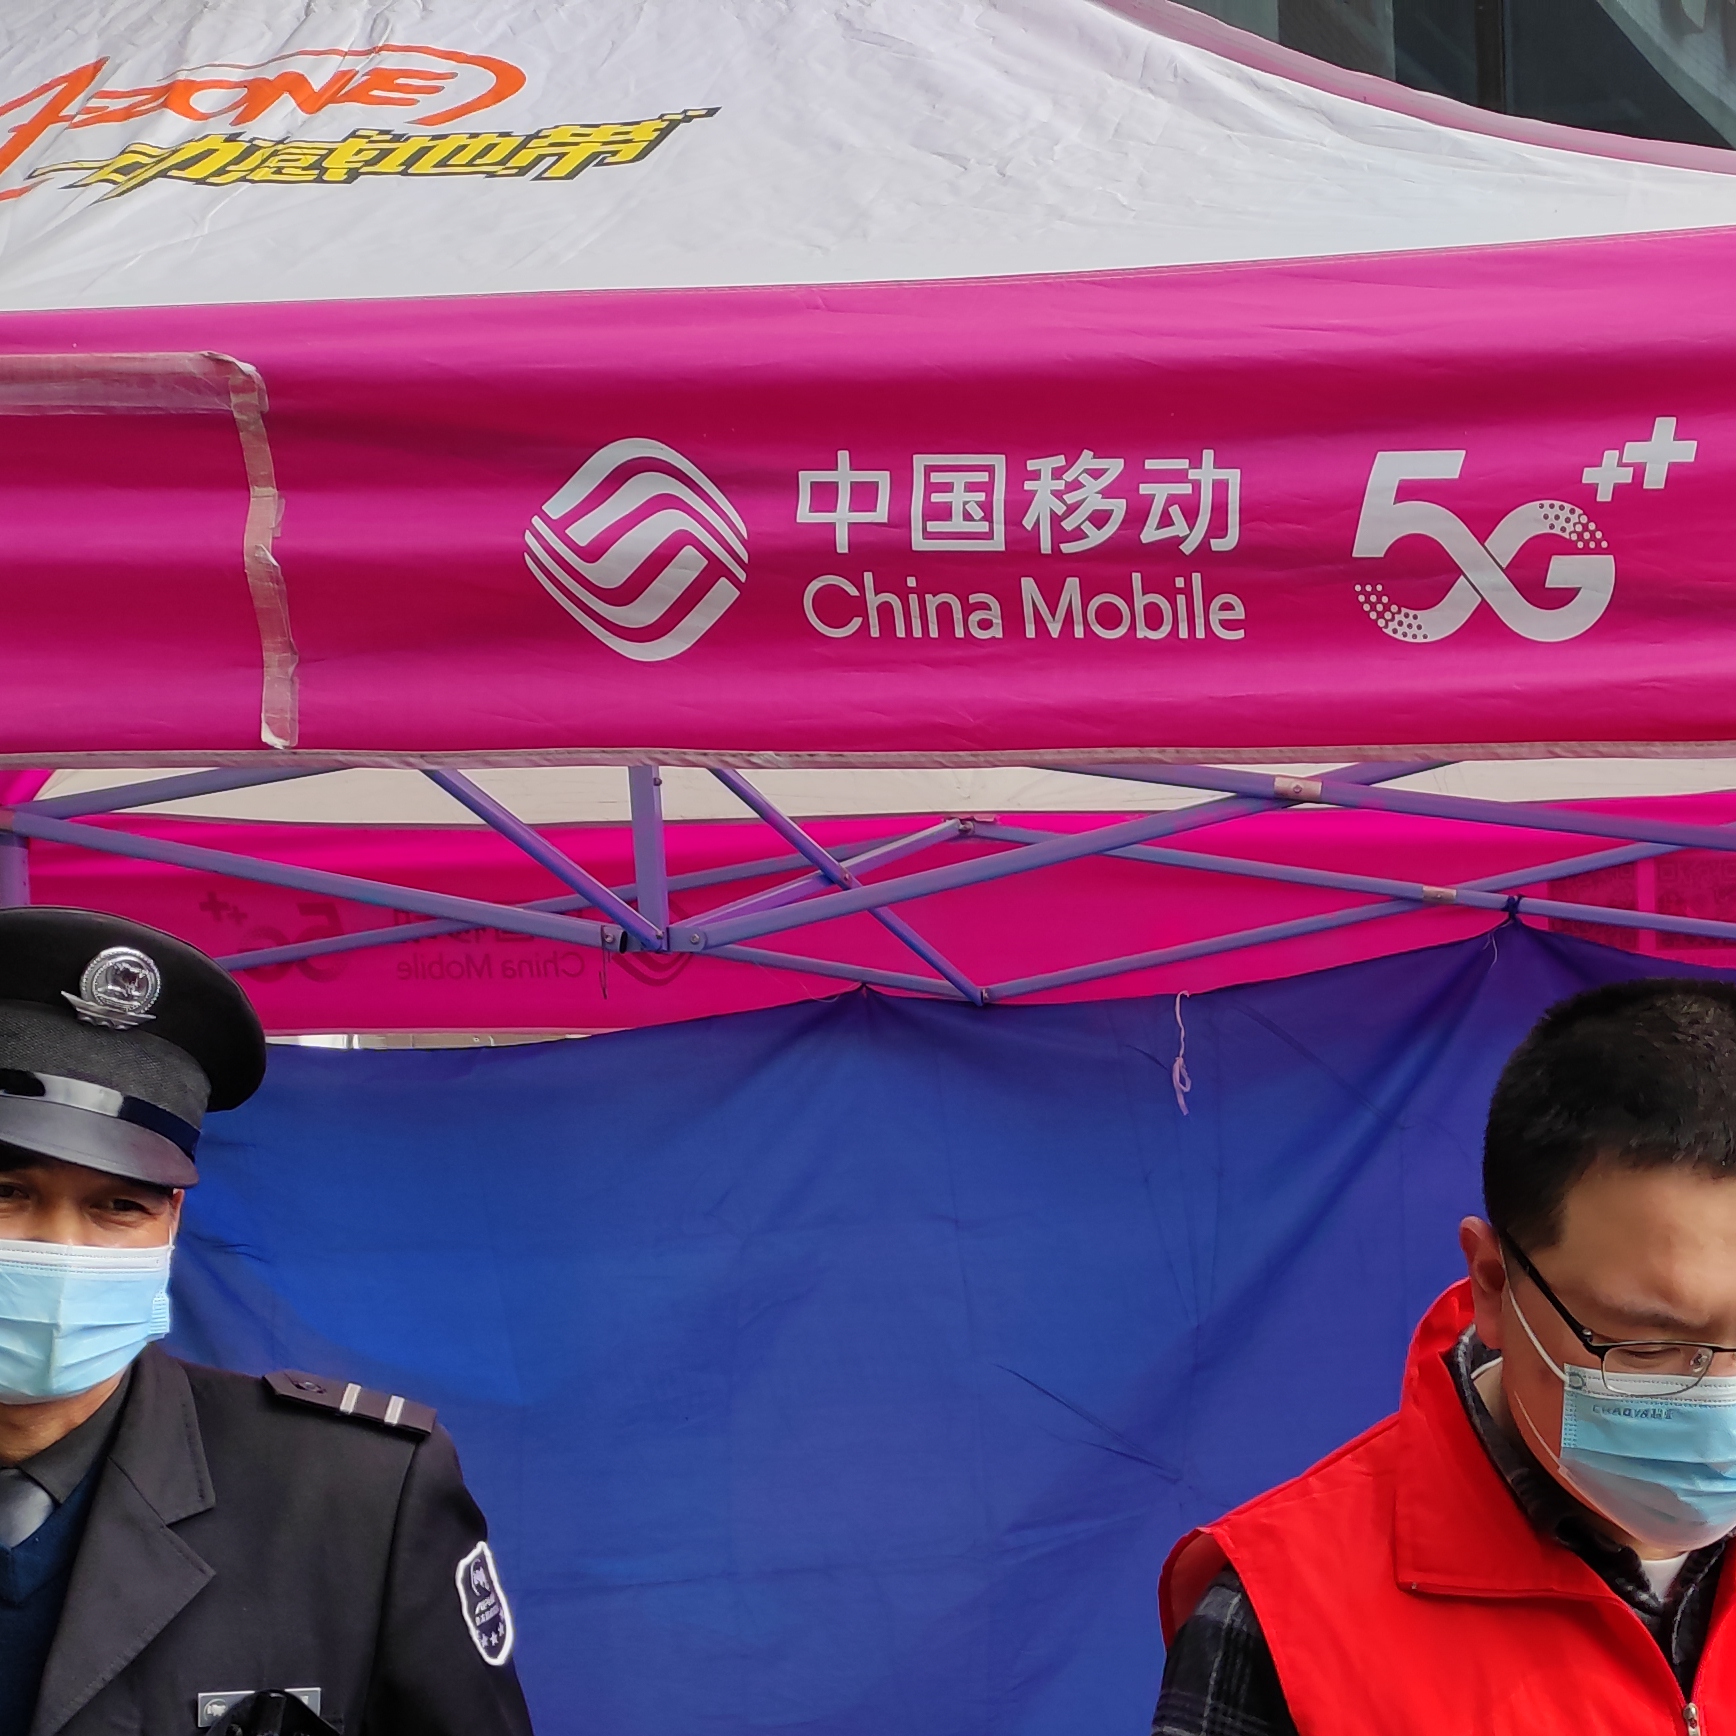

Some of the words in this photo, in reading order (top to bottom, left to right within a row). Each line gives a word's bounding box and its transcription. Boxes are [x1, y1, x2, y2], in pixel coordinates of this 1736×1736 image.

[28, 106, 722, 207] 动感地带
[795, 449, 1242, 556] 中国移动
[802, 571, 1004, 639] China
[1020, 572, 1246, 640] Mobile
